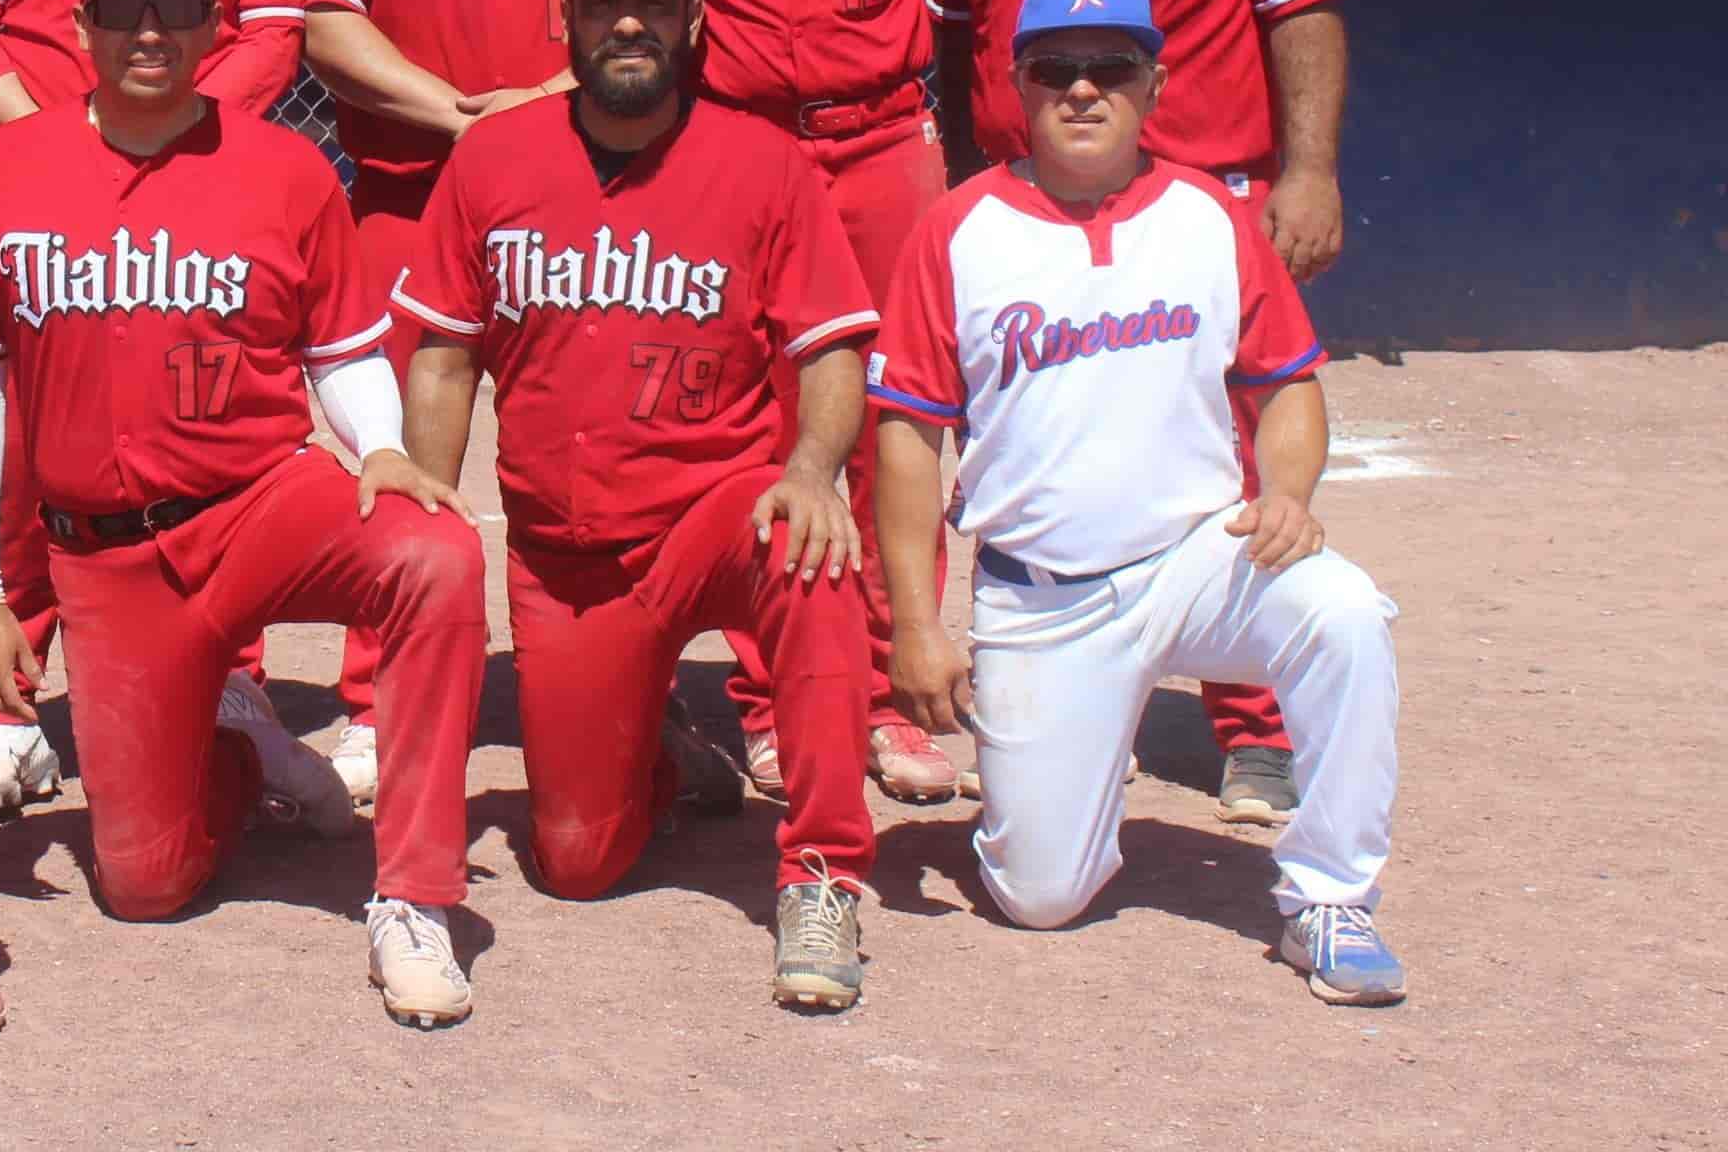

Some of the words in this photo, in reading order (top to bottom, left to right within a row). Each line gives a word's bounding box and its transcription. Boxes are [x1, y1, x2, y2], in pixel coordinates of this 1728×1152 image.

[486, 224, 730, 325] Diablos
[167, 340, 242, 422] 17
[630, 343, 724, 423] 79
[991, 299, 1201, 392] Ribereña
